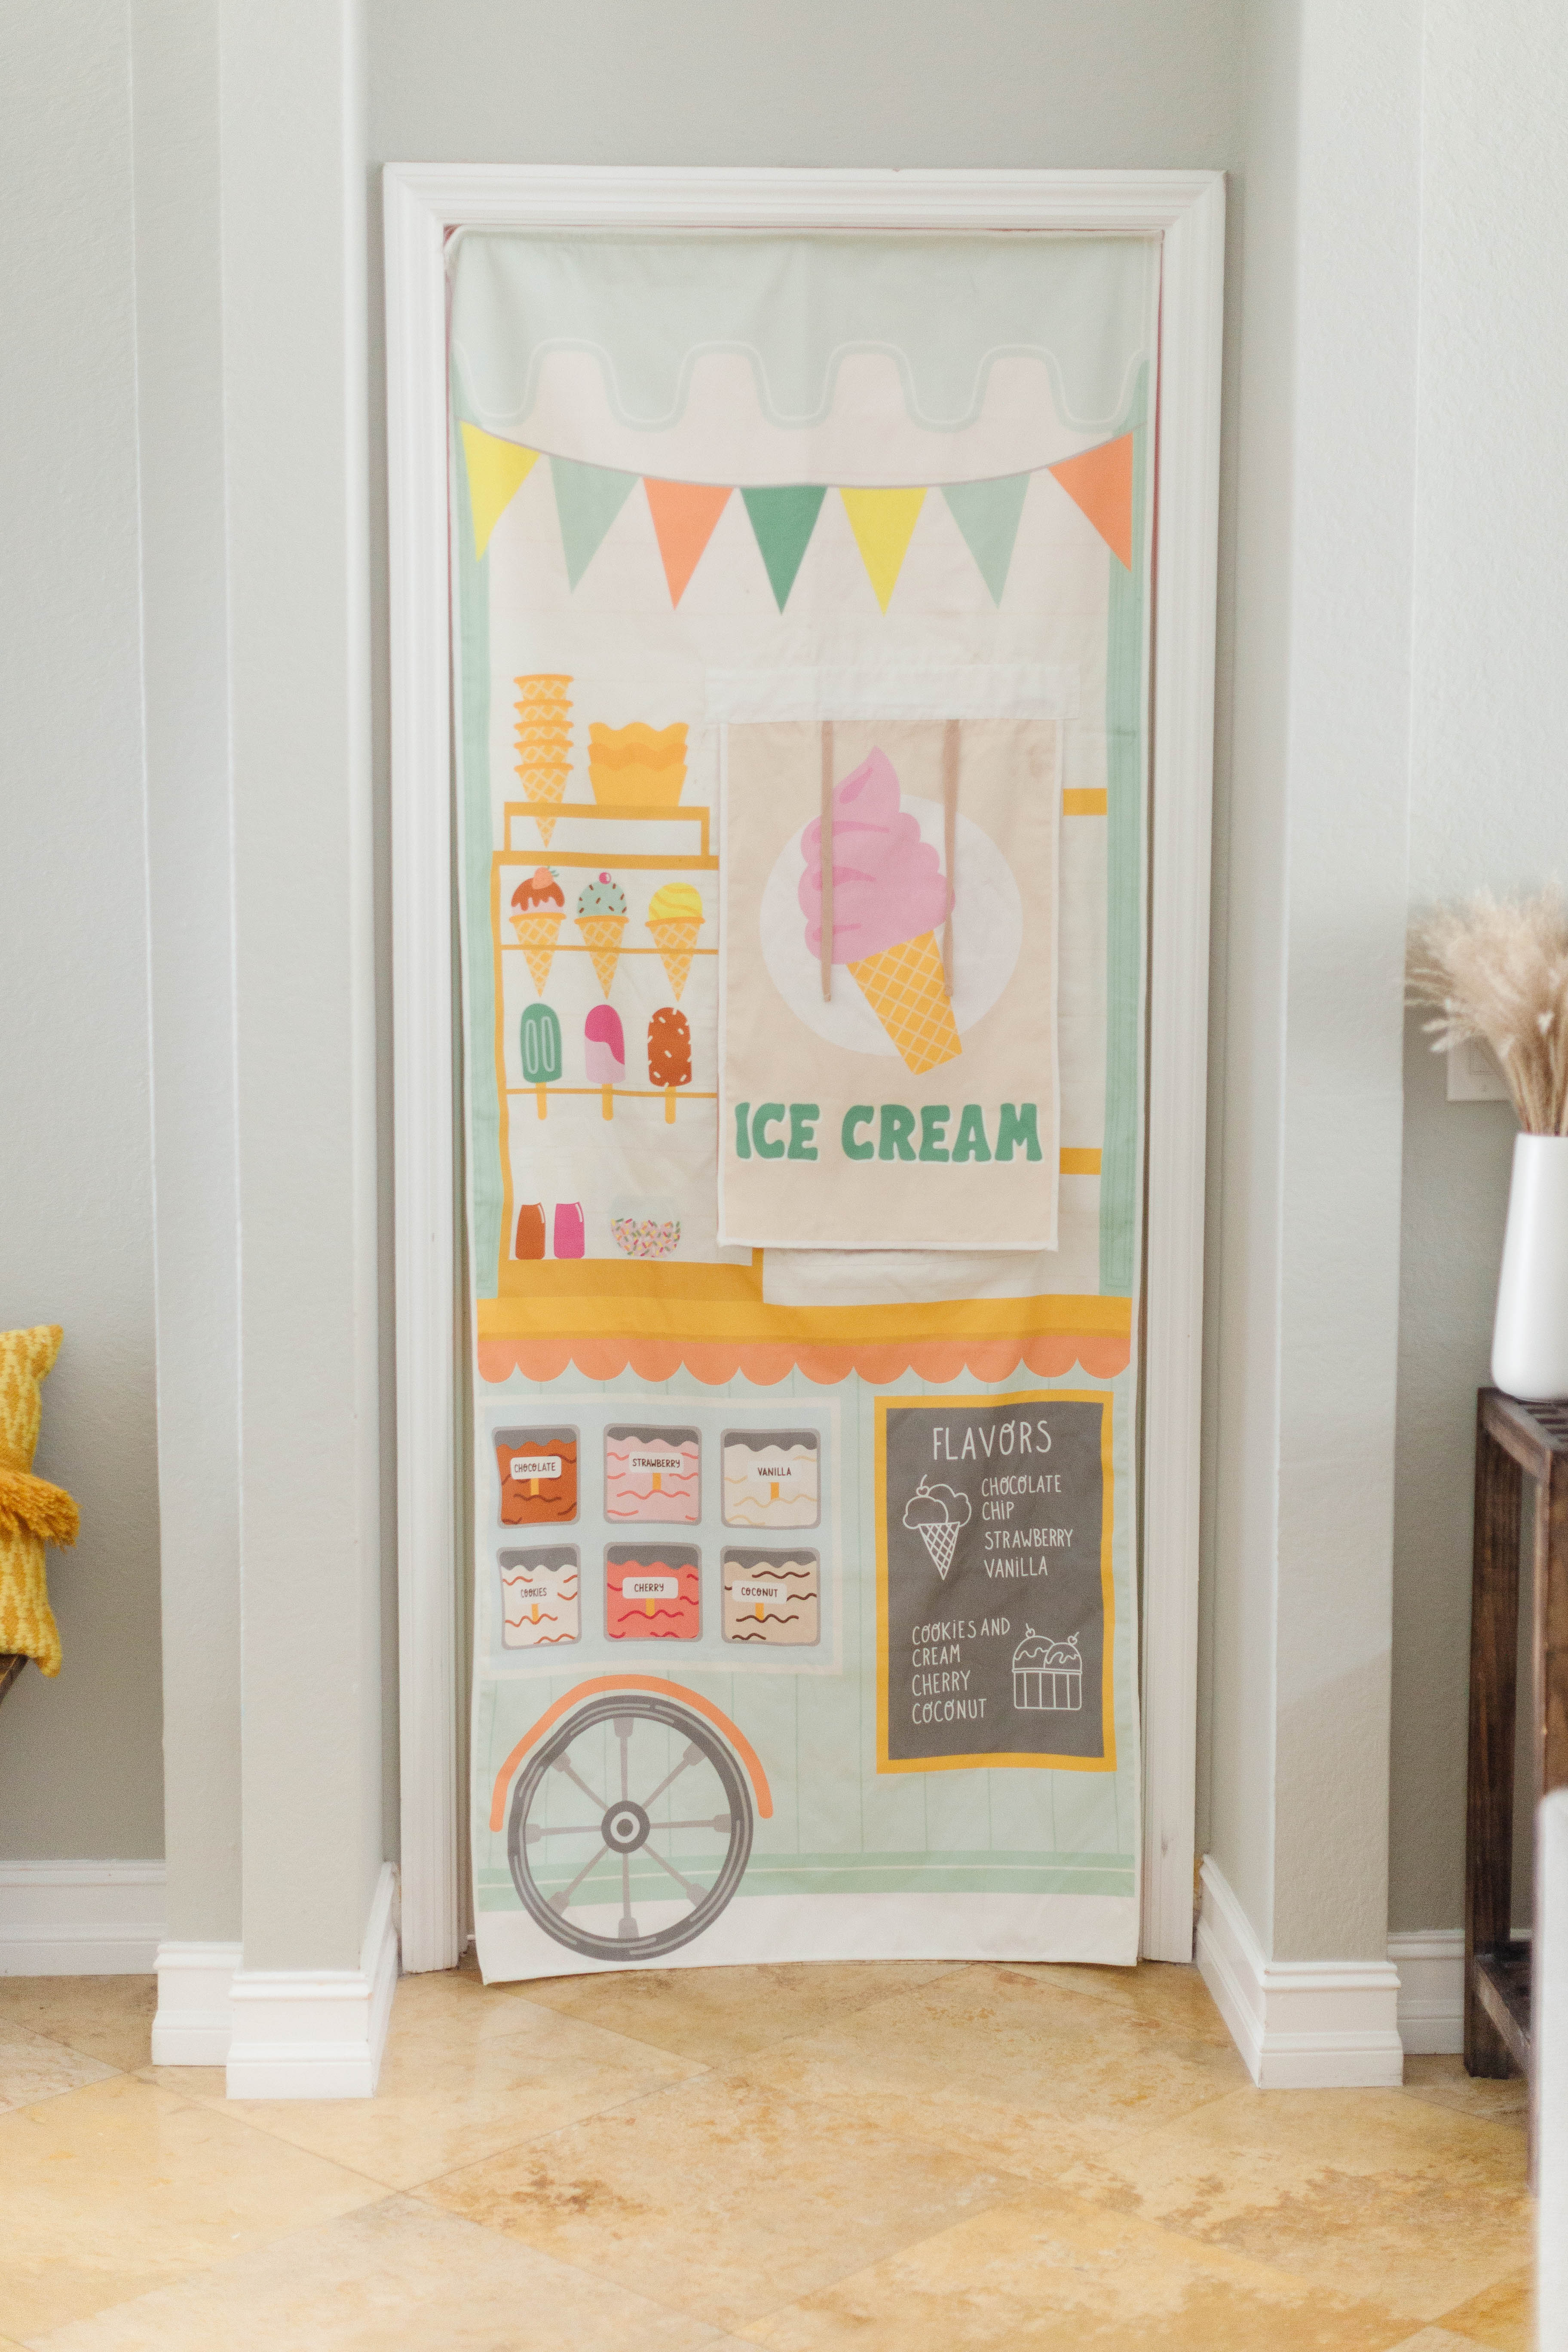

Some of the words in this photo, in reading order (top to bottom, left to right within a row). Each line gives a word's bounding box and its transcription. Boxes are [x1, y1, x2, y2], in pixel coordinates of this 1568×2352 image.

[735, 1102, 820, 1161] ICE
[841, 1103, 1043, 1162] CREAM
[933, 1420, 1052, 1460] FLAVORS
[514, 1461, 556, 1473] CHOCOLATE
[632, 1458, 680, 1469] STRAWBERRY
[758, 1467, 791, 1477] VANILLA
[981, 1474, 1062, 1497] CHOCOLATE
[984, 1528, 1073, 1550] STRAWBERRY
[521, 1587, 547, 1599] COOKIES
[634, 1583, 664, 1594] CHERRY
[741, 1587, 778, 1598] COCONUT
[980, 1617, 1011, 1636] AND
[912, 1644, 961, 1667] CREAM
[912, 1670, 971, 1697] CHERRY
[912, 1698, 987, 1724] COCONUT
